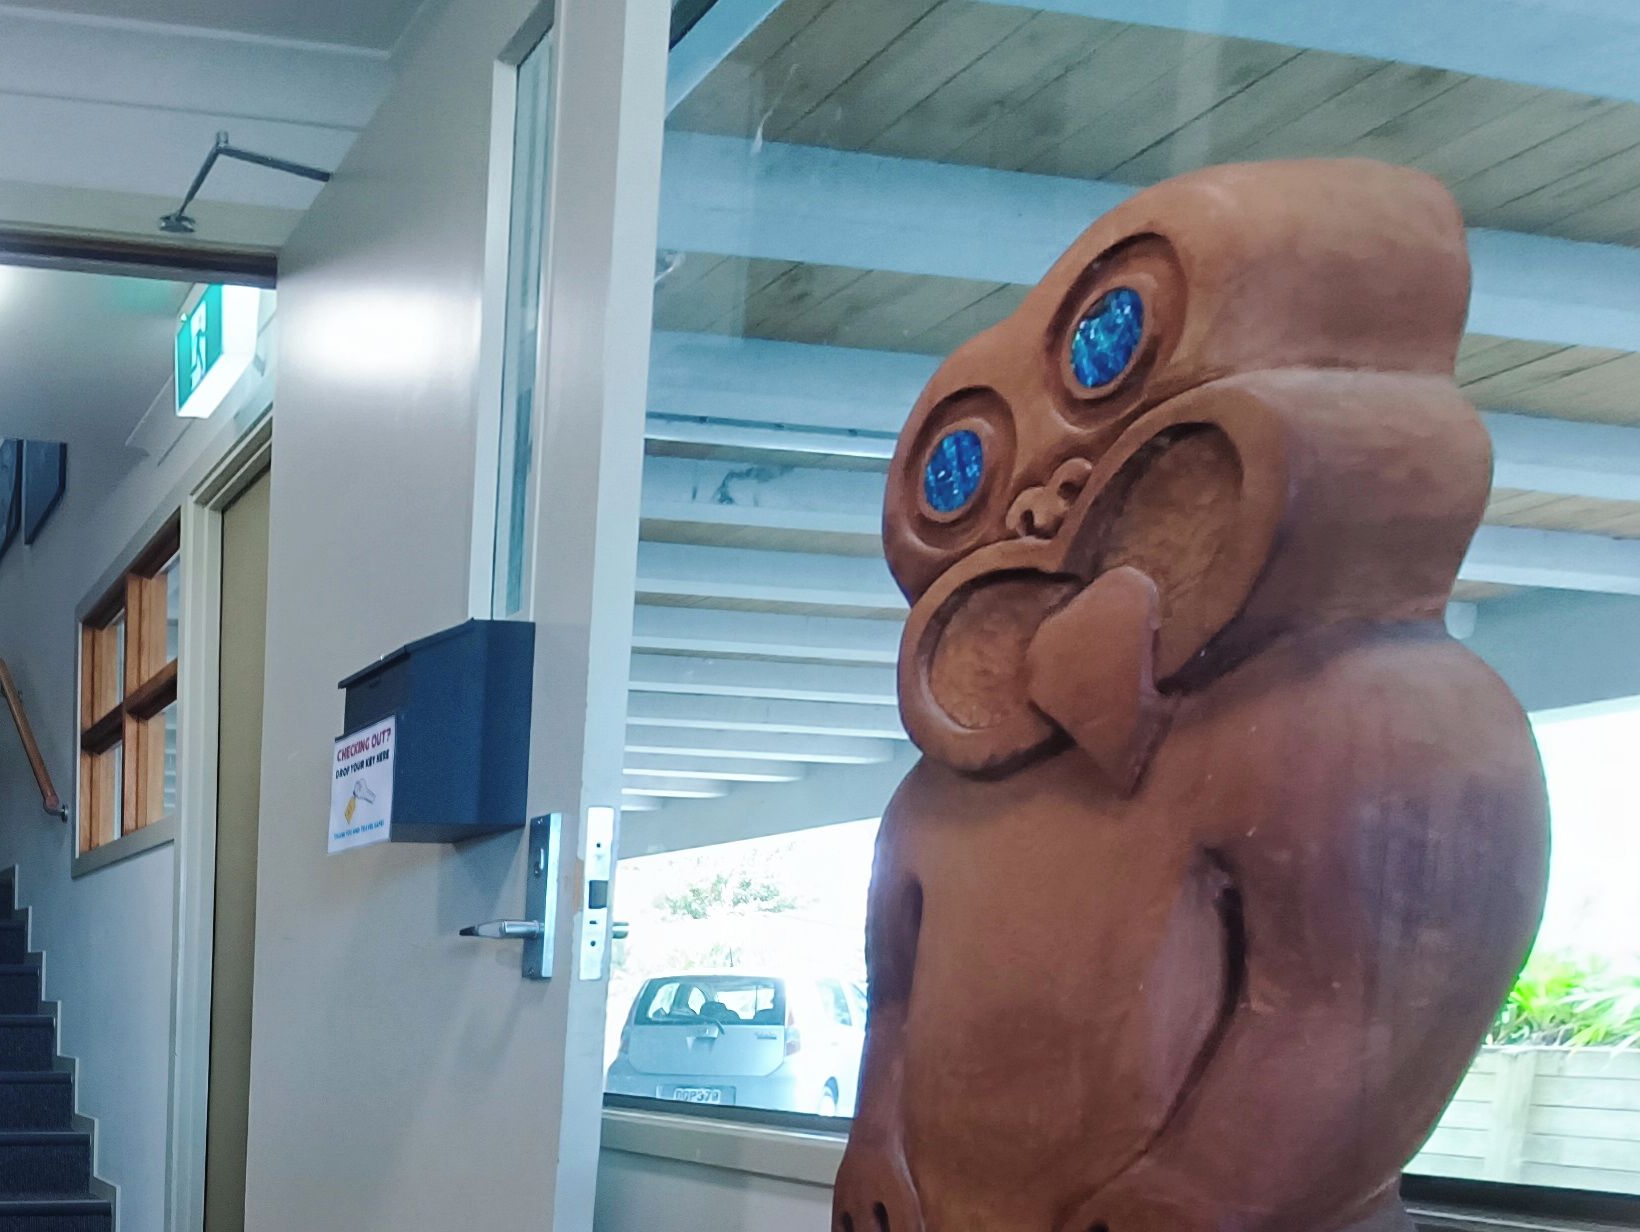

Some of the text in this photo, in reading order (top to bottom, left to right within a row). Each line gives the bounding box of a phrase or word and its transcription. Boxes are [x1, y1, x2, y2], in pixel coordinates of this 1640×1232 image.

[337, 727, 391, 762] CHECKING OUT?
[336, 749, 389, 779] DROP YOUR KEY HERE
